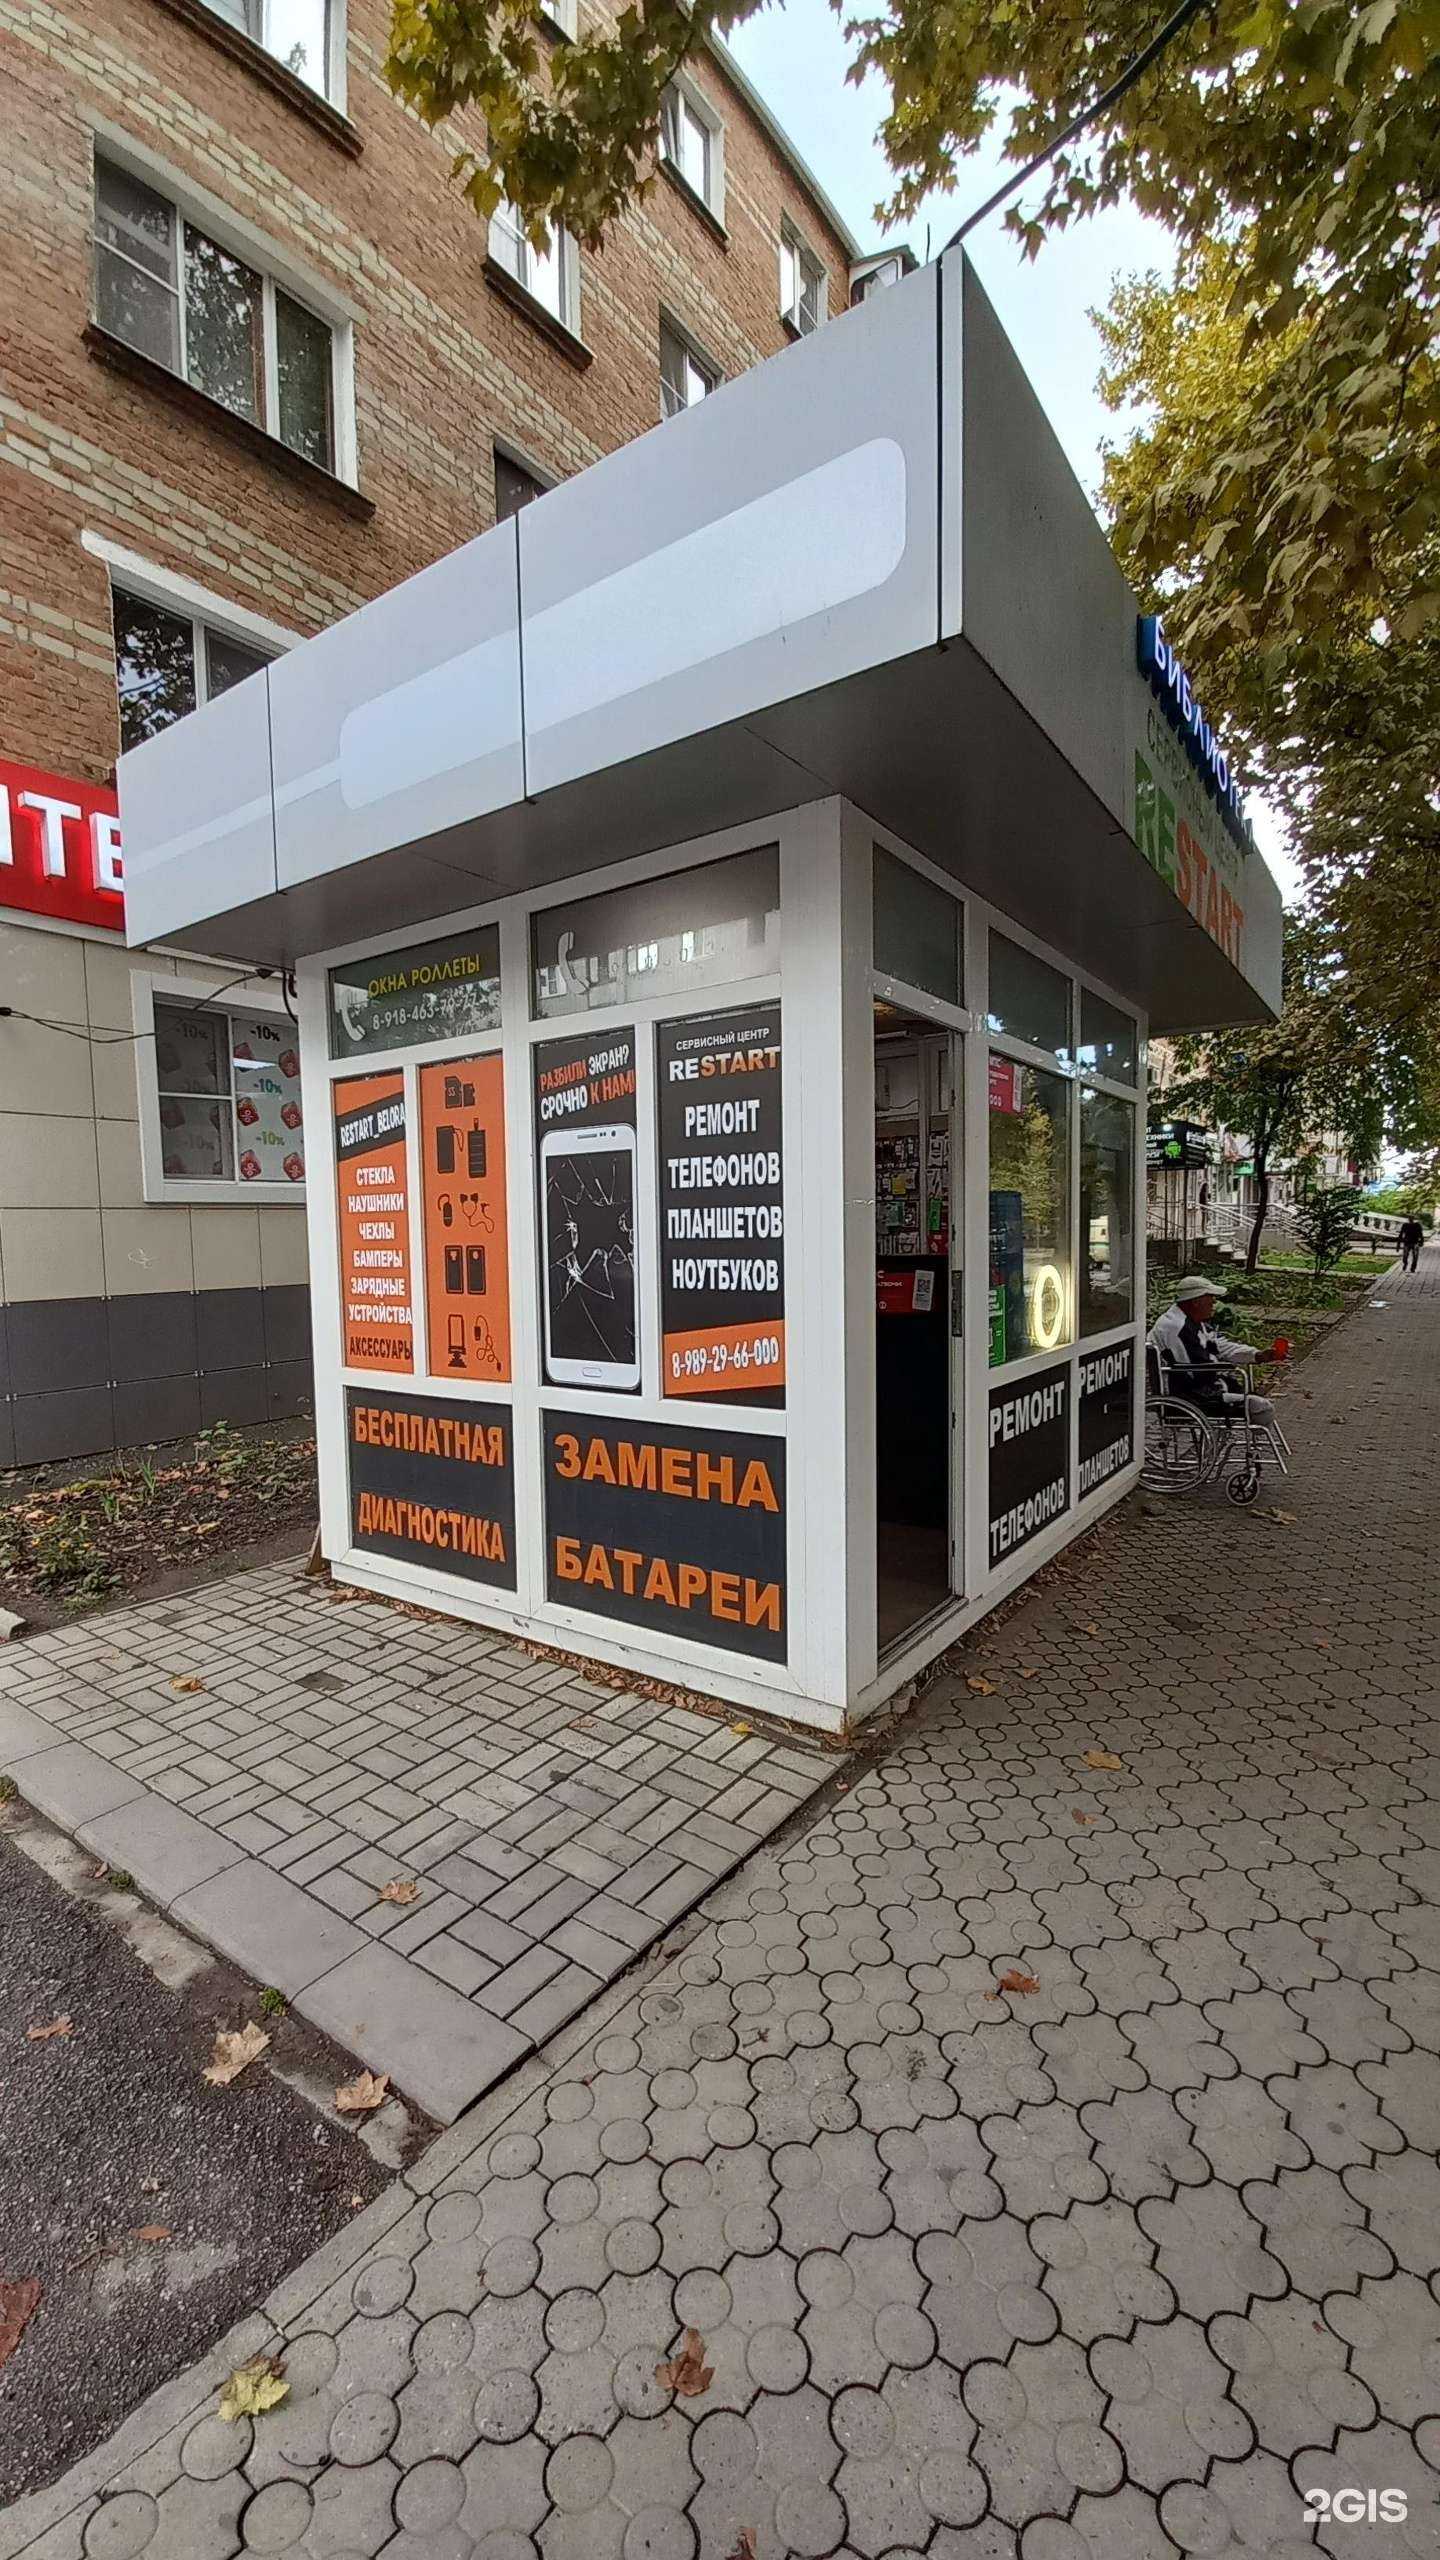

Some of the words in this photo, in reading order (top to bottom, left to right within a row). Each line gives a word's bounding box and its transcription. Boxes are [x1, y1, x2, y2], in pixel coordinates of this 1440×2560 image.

[367, 974, 407, 998] ОКНА
[411, 954, 481, 986] РОЛЛЕТЫ
[251, 1024, 280, 1042] -10%
[676, 1031, 735, 1051] СЕРВИСНЫЙ
[737, 1027, 770, 1043] ЦЕНТР
[541, 1060, 587, 1092] РАЗБИЛИ
[588, 1044, 630, 1076] ЭКРАН?
[668, 1046, 781, 1082] RESTART
[254, 1078, 282, 1095] -10%
[541, 1084, 588, 1120] СРОЧНО
[590, 1081, 600, 1105] К
[685, 1099, 761, 1138] РЕМОНТ
[256, 1131, 285, 1146] -10%
[356, 1166, 396, 1186] СТЕКЛА
[668, 1151, 781, 1189] ТЕЛЕФОНОВ
[348, 1193, 404, 1213] НАУШНИКИ
[358, 1222, 395, 1240] ЧЕХЛЫ
[667, 1205, 783, 1240] ПЛАНШЕТОВ
[353, 1250, 403, 1268] БАМПЕРЫ
[672, 1258, 779, 1291] НОУТБУКОВ
[350, 1277, 405, 1298] ЗАРЯДНЫЕ
[349, 1302, 413, 1325] УСТРОЙСТВА
[349, 1336, 414, 1361] АКСЕССУАРЫ
[672, 1336, 779, 1378] 8-989-29-66-000
[1078, 1351, 1130, 1400] РЕМОНТ
[989, 1381, 1065, 1449] РЕМОНТ
[354, 1406, 504, 1467] БЕСПЛАТНАЯ
[554, 1433, 780, 1513] ЗАМЕНА
[1078, 1434, 1130, 1492] ПЛАНШЕТОВ
[358, 1491, 505, 1564] ДИАГНОСТИКА
[990, 1477, 1065, 1557] ТЕЛЕФОНОВ
[555, 1535, 781, 1632] БАТАРЕИ
